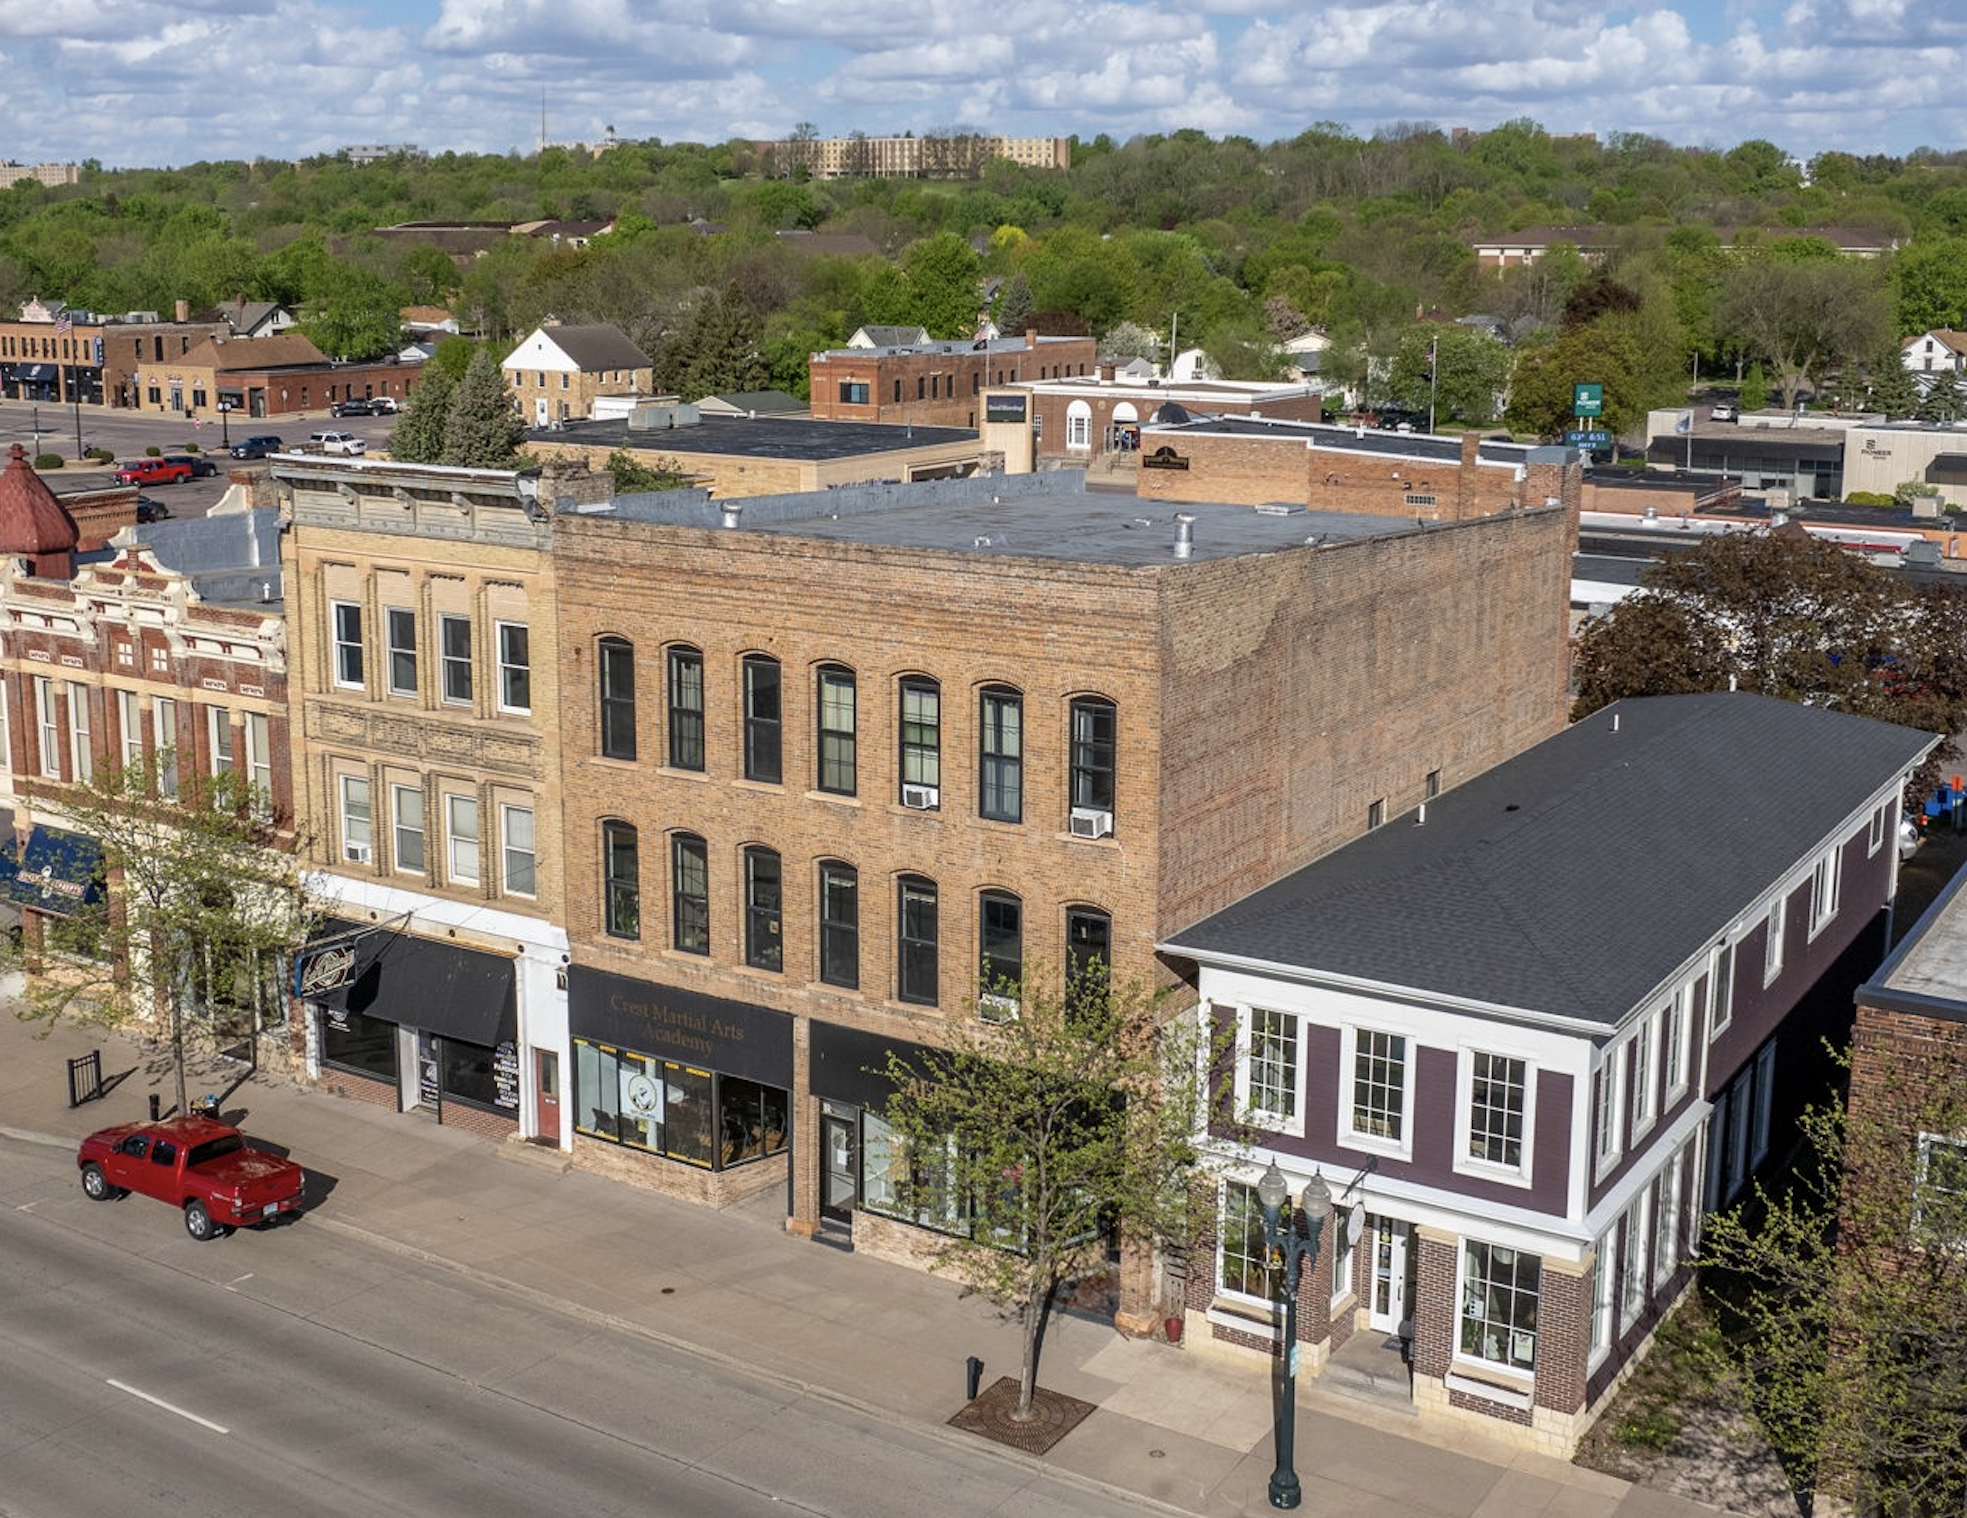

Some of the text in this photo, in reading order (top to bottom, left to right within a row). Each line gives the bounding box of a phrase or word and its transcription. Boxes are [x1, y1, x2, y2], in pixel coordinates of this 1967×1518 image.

[610, 993, 745, 1040] Crest Martial Arts
[643, 1021, 714, 1057] Academy
